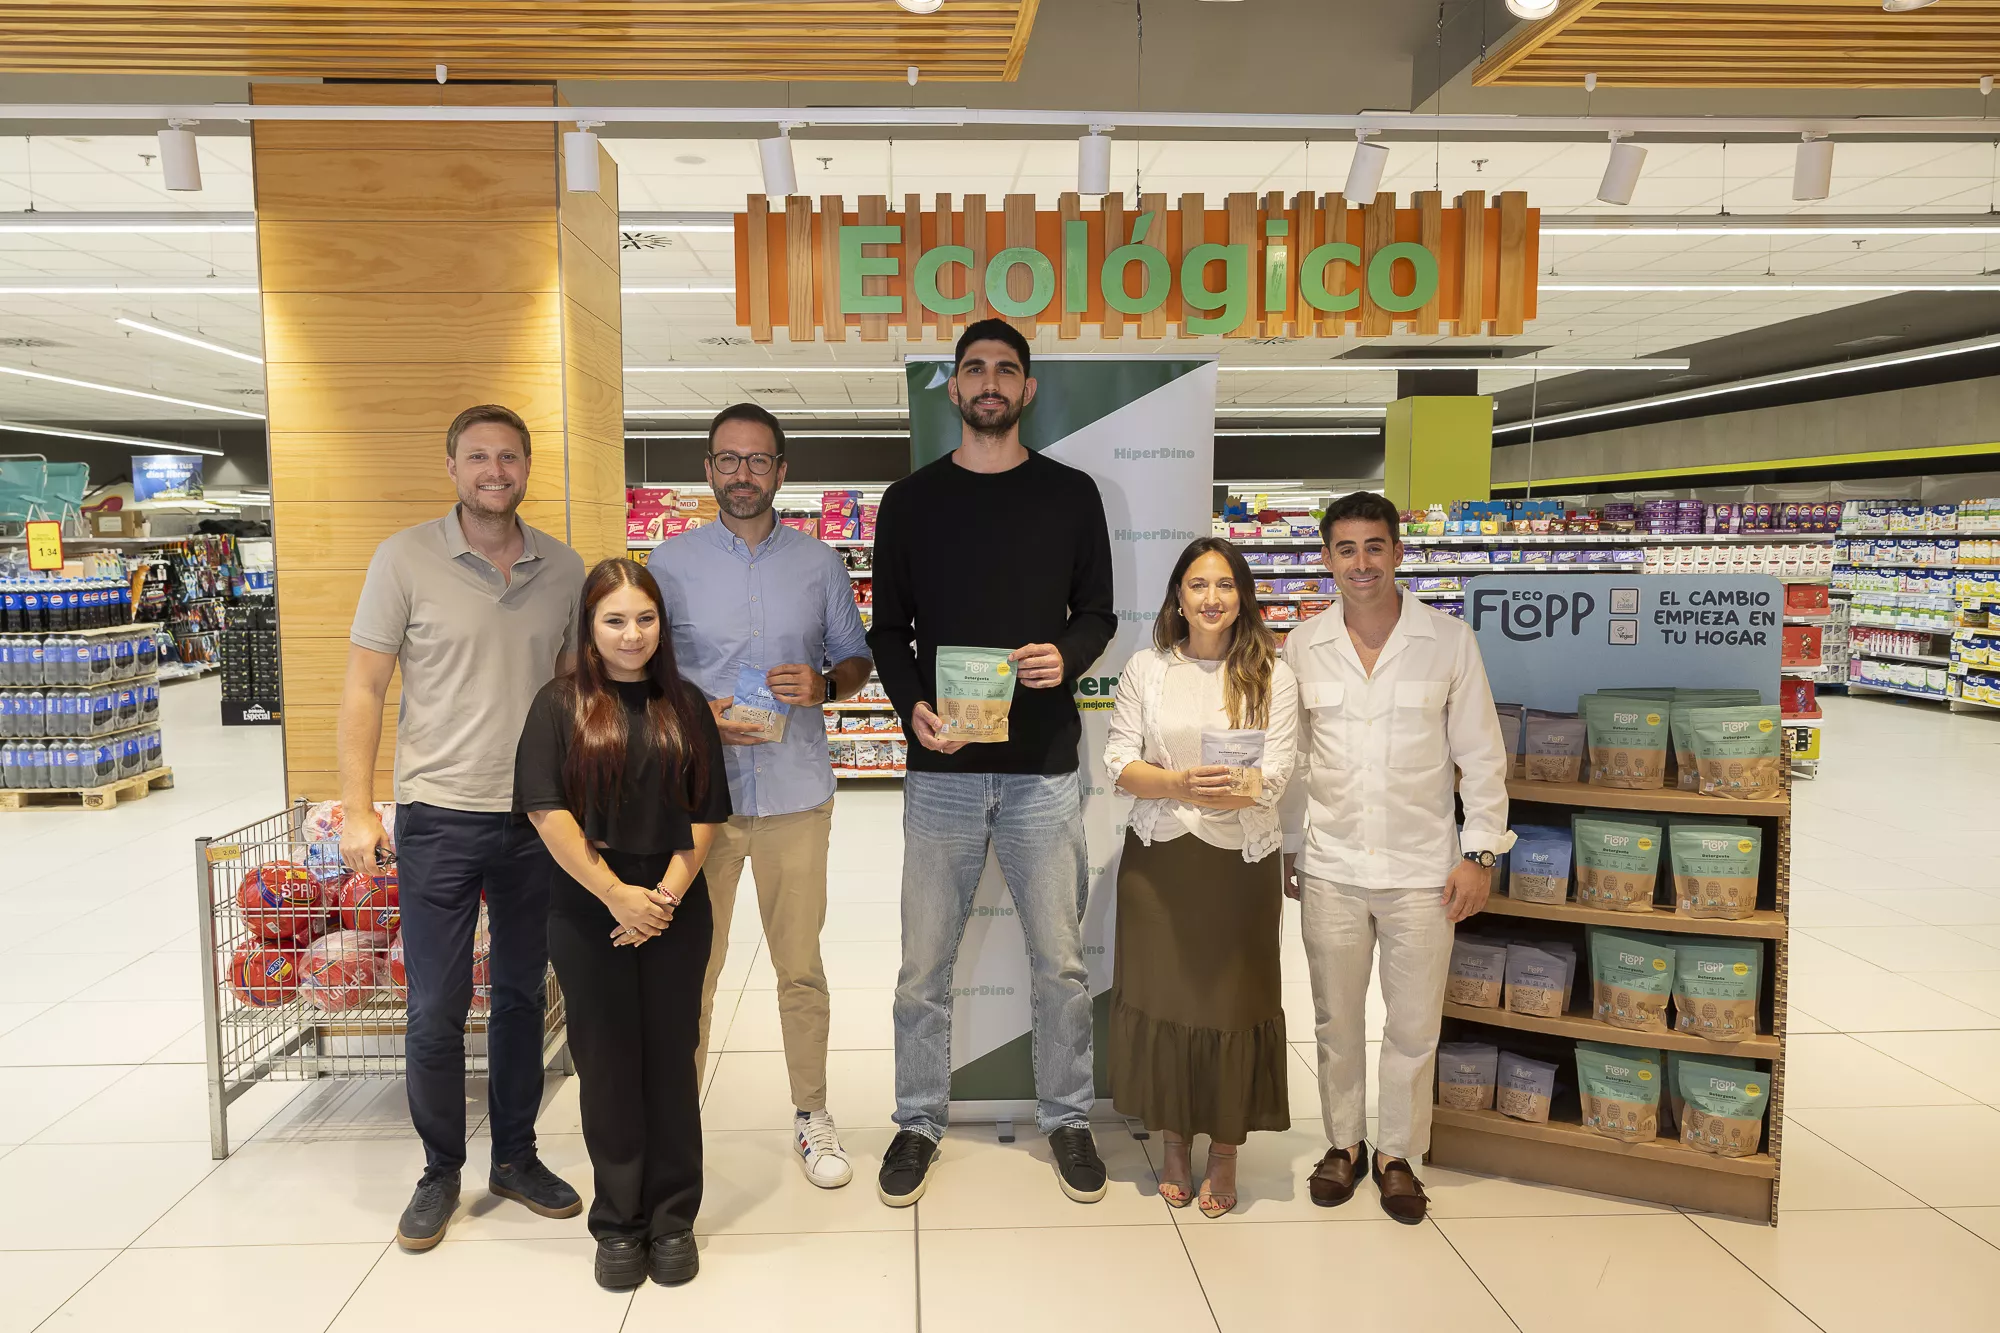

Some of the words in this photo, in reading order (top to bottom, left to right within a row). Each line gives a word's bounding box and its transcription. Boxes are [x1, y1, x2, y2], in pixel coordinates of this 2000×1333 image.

[838, 213, 1439, 335] Ecológico
[1114, 448, 1195, 460] HiperDino
[1114, 529, 1196, 542] HiperDino
[1512, 591, 1543, 601] ECO
[1660, 591, 1681, 606] EL
[1688, 590, 1770, 607] CAMBIO
[1115, 610, 1160, 622] Hiper
[1653, 610, 1740, 626] EMPIEZA
[1749, 611, 1776, 626] EN
[1660, 629, 1687, 645] TU
[1695, 630, 1767, 646] HOGAR
[1083, 700, 1115, 710] mejores
[243, 710, 270, 722] Especial
[971, 906, 1014, 917] rDino
[950, 985, 1015, 997] perDino
